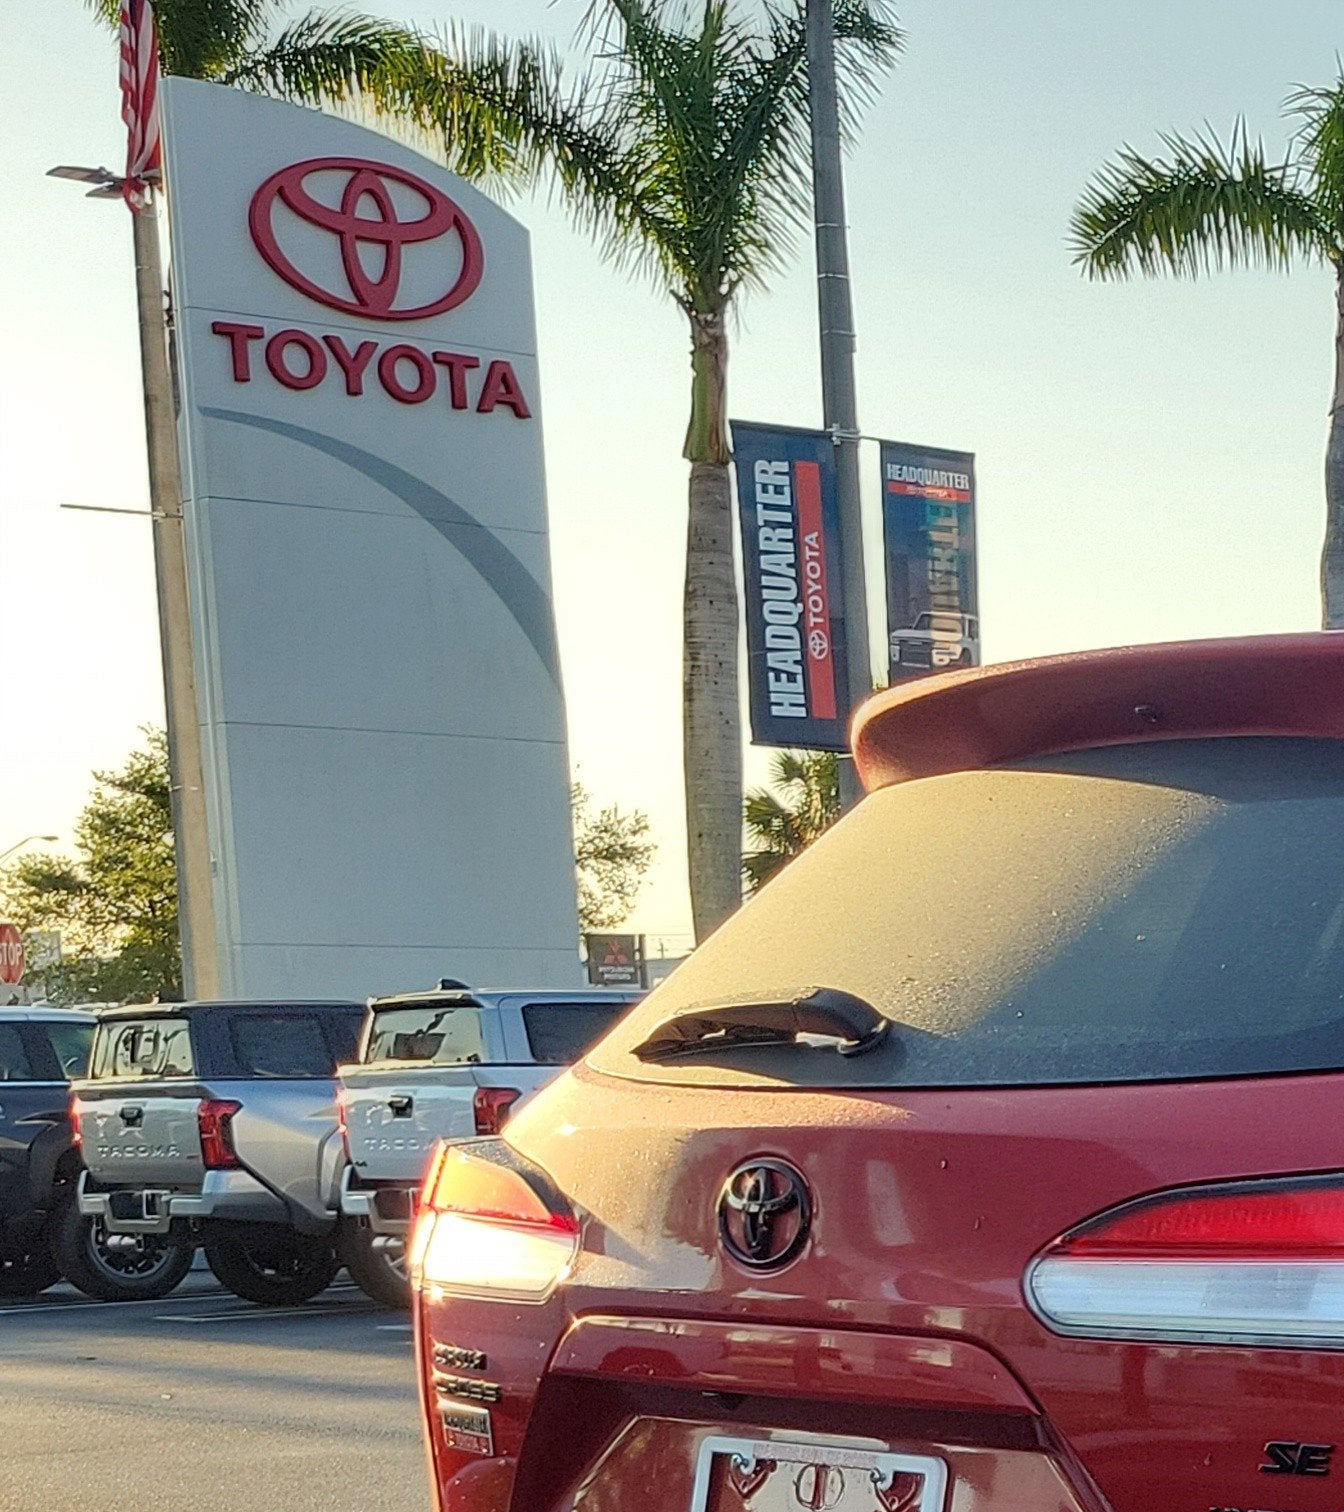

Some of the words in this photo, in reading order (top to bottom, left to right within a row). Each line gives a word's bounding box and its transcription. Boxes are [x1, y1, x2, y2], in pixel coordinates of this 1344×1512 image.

[211, 321, 532, 419] TOYOTA
[886, 463, 970, 490] HEADQUARTER
[754, 459, 808, 718] HEADQUARTER
[802, 531, 824, 627] TOYOTA
[0, 943, 22, 966] TOP
[97, 1144, 181, 1158] TACOMA
[1257, 1441, 1334, 1475] SE
